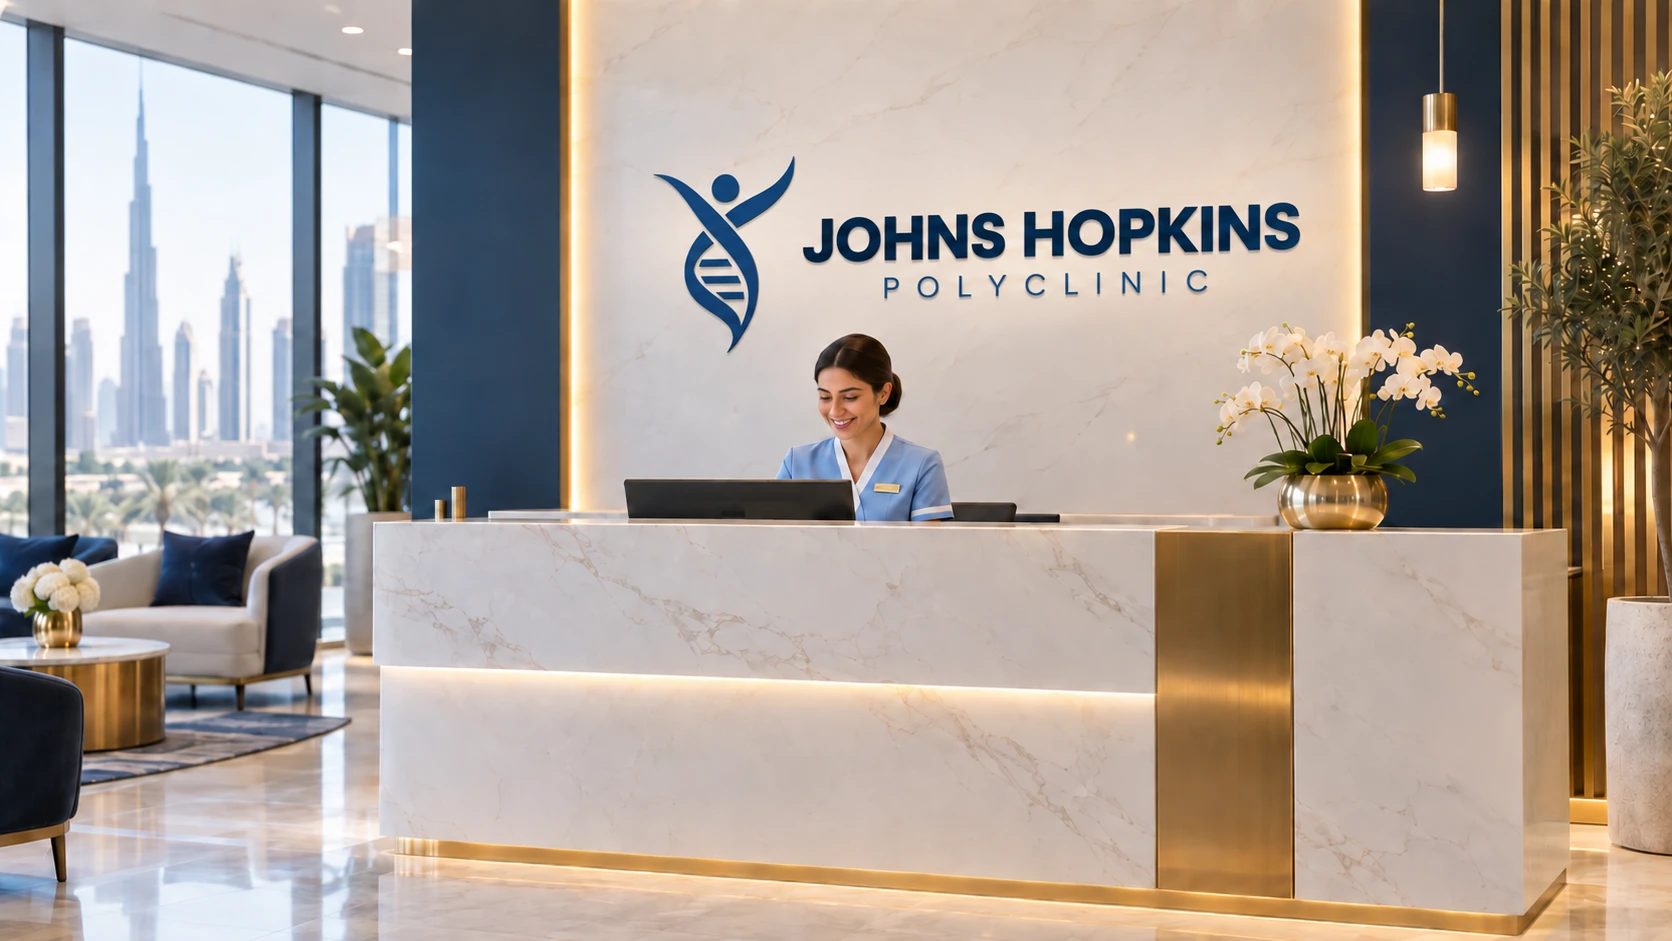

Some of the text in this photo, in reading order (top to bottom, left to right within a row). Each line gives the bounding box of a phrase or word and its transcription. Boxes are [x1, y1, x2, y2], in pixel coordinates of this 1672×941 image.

[802, 202, 1301, 263] JOHNS HOPKINS
[883, 269, 1210, 299] POLYCLINIC
